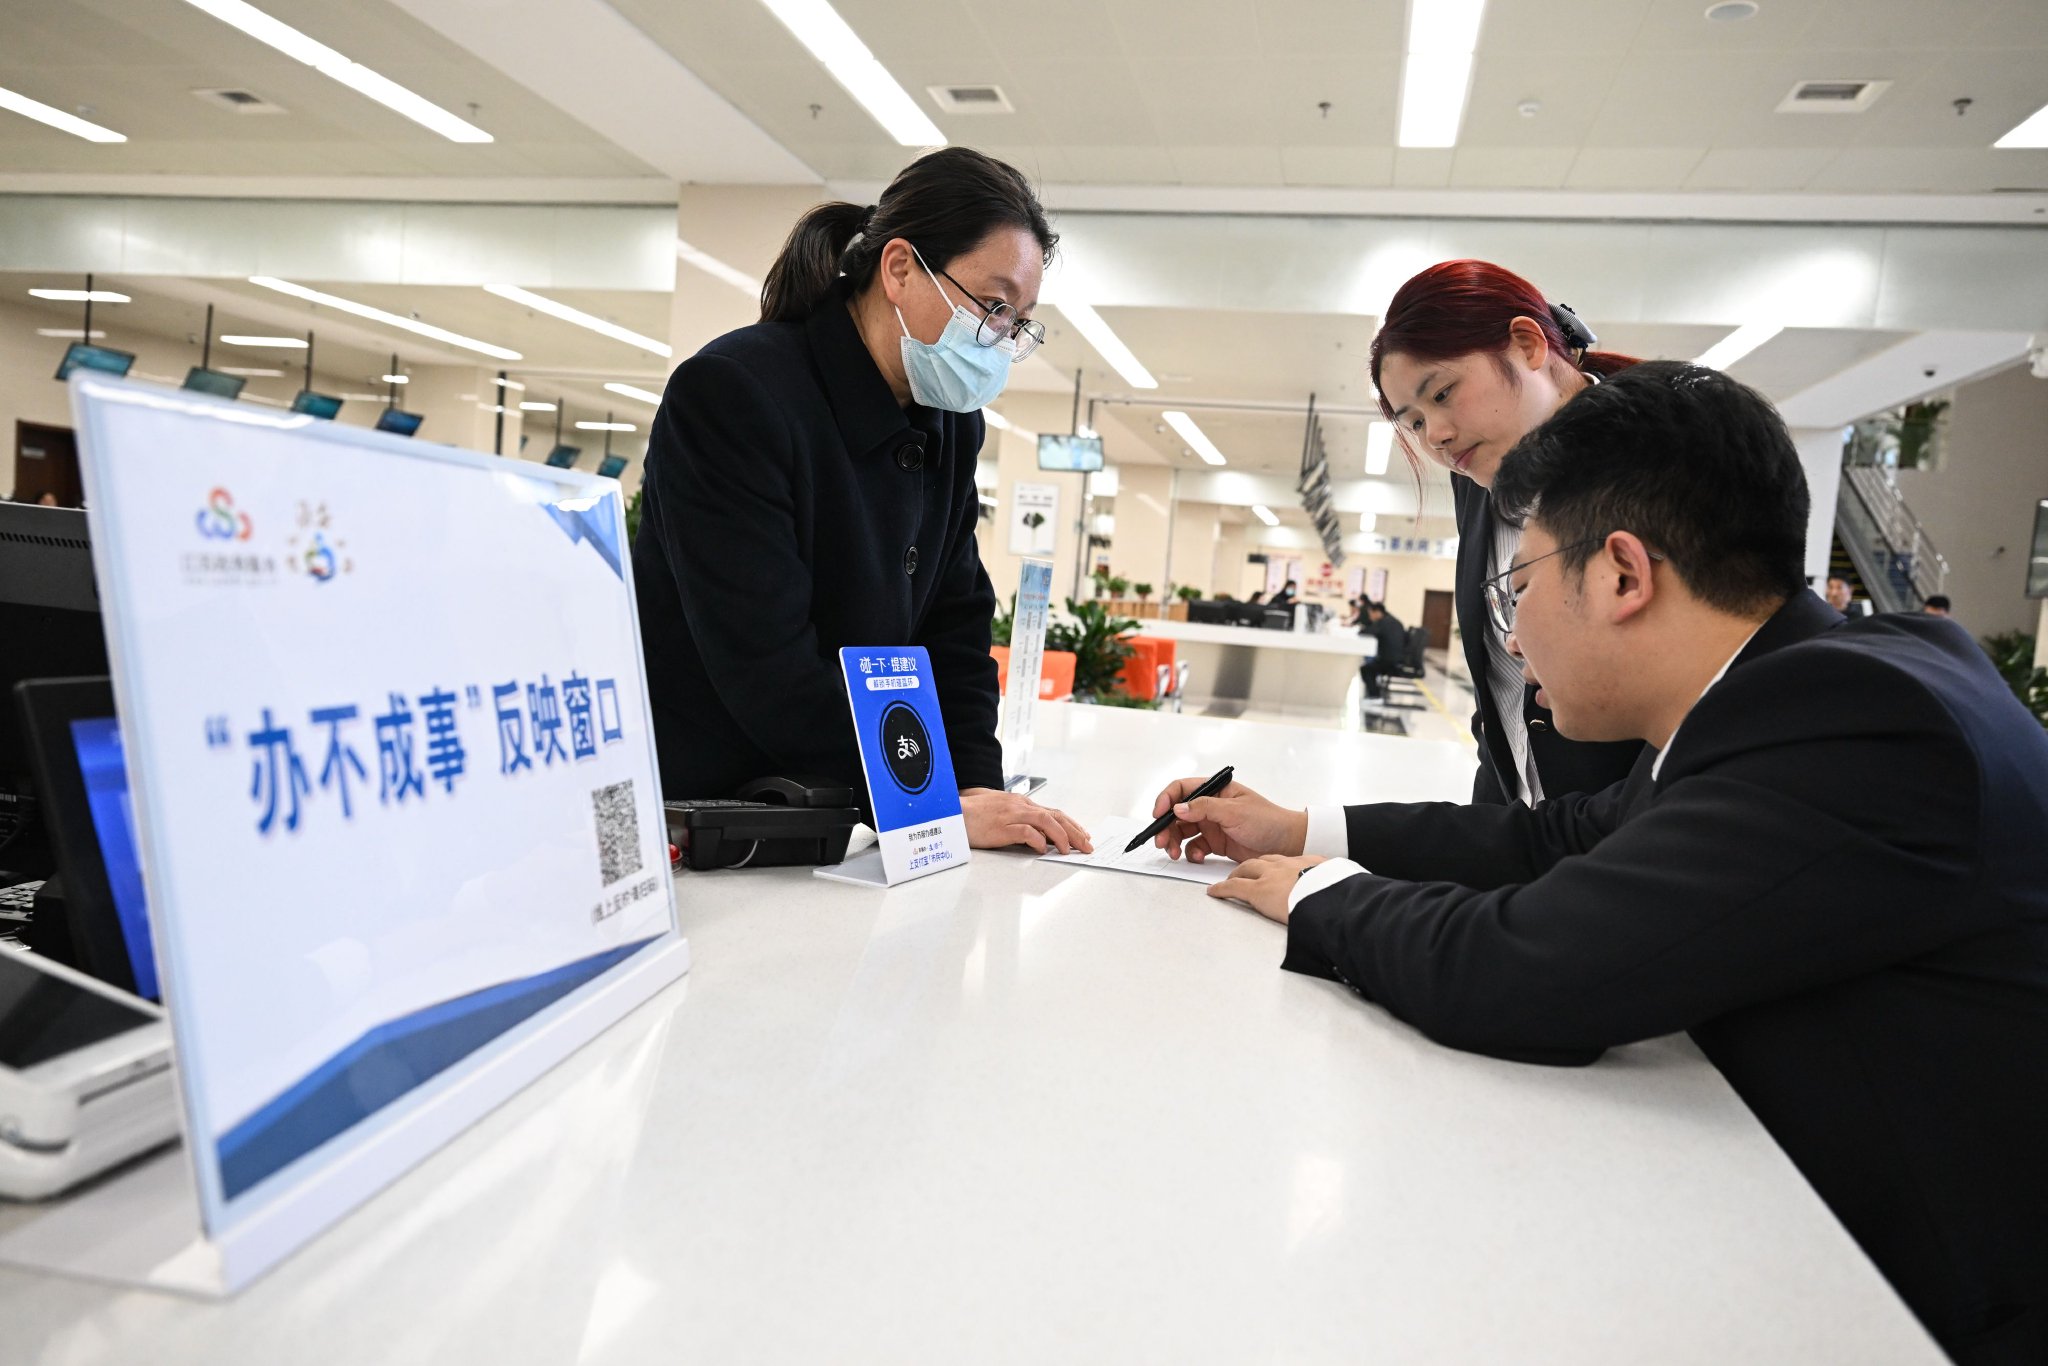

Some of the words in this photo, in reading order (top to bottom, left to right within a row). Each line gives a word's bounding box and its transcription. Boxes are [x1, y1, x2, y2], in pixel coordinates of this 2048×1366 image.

[204, 669, 623, 834] “办不成事”反映窗口
